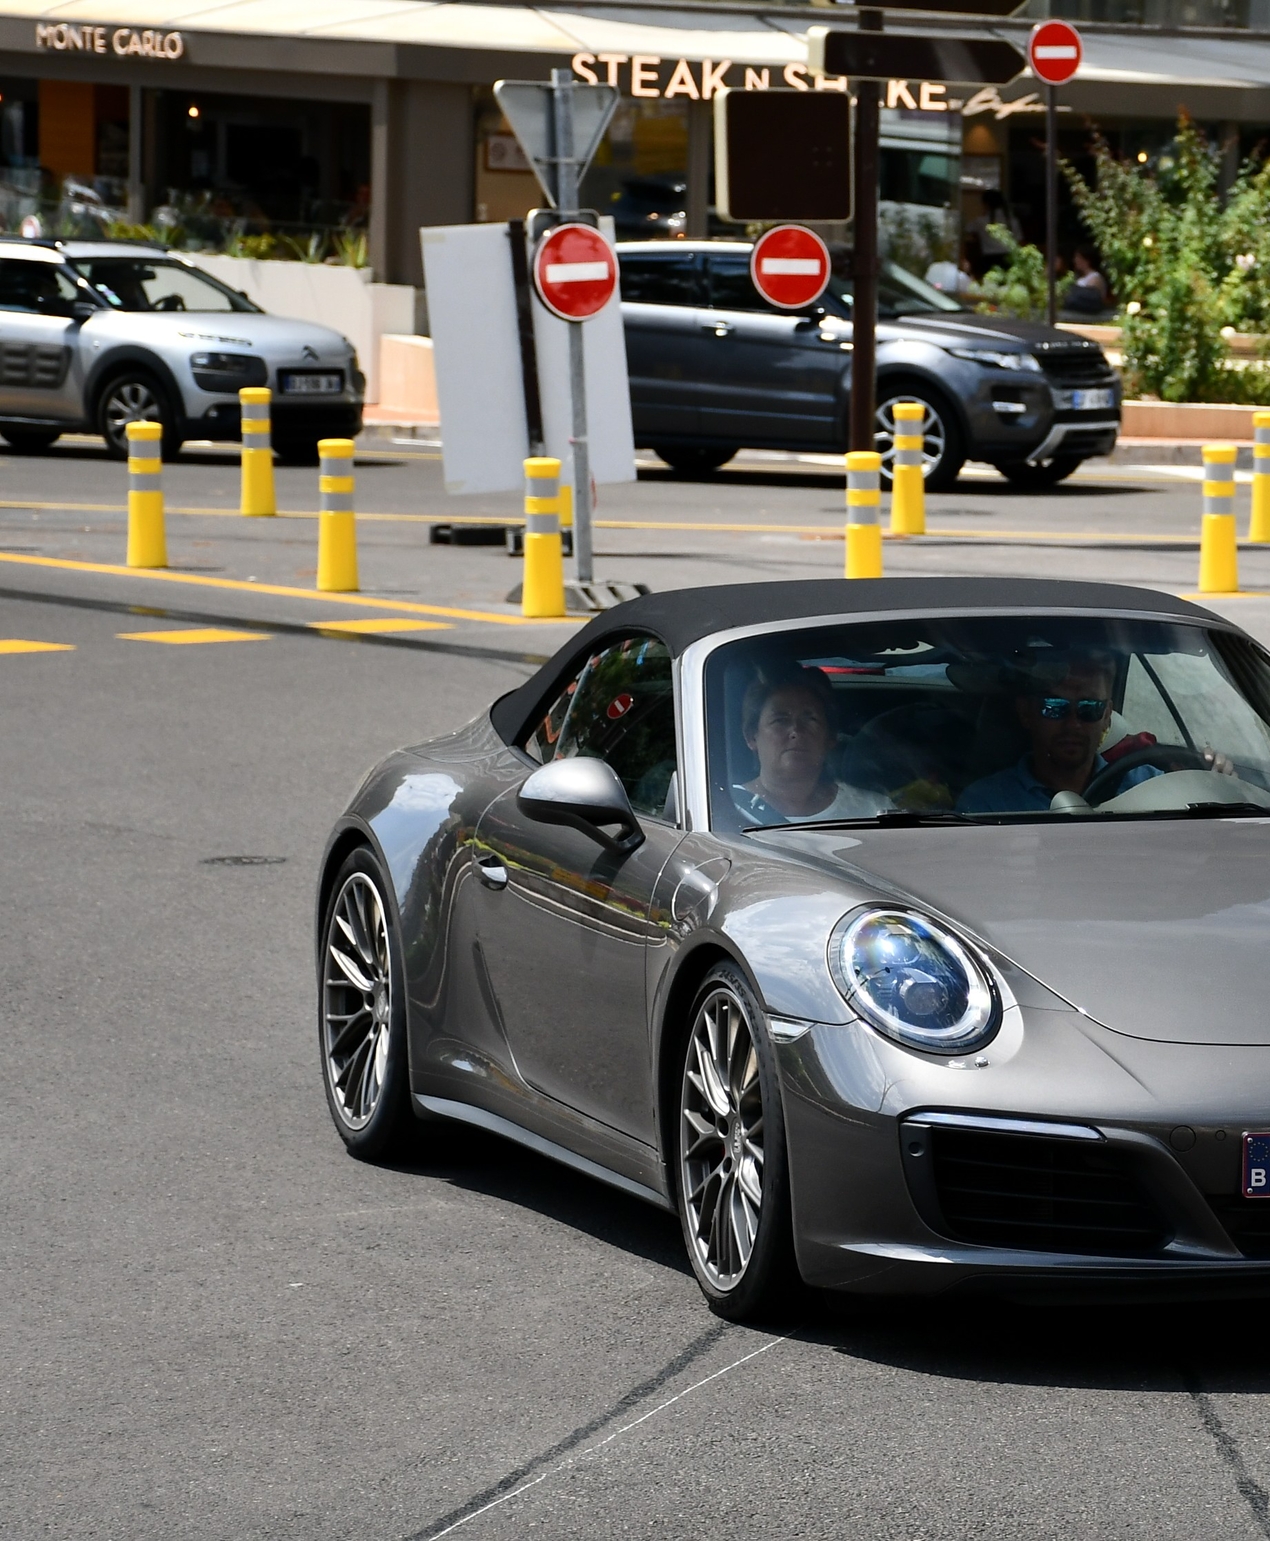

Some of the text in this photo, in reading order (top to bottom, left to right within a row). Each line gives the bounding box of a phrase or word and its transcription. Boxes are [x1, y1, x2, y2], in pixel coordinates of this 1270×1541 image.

[35, 22, 184, 60] MONTE CARLO
[571, 51, 733, 101] STEAK
[744, 67, 770, 91] N
[783, 62, 948, 111] SKE
[1250, 1168, 1267, 1187] B
